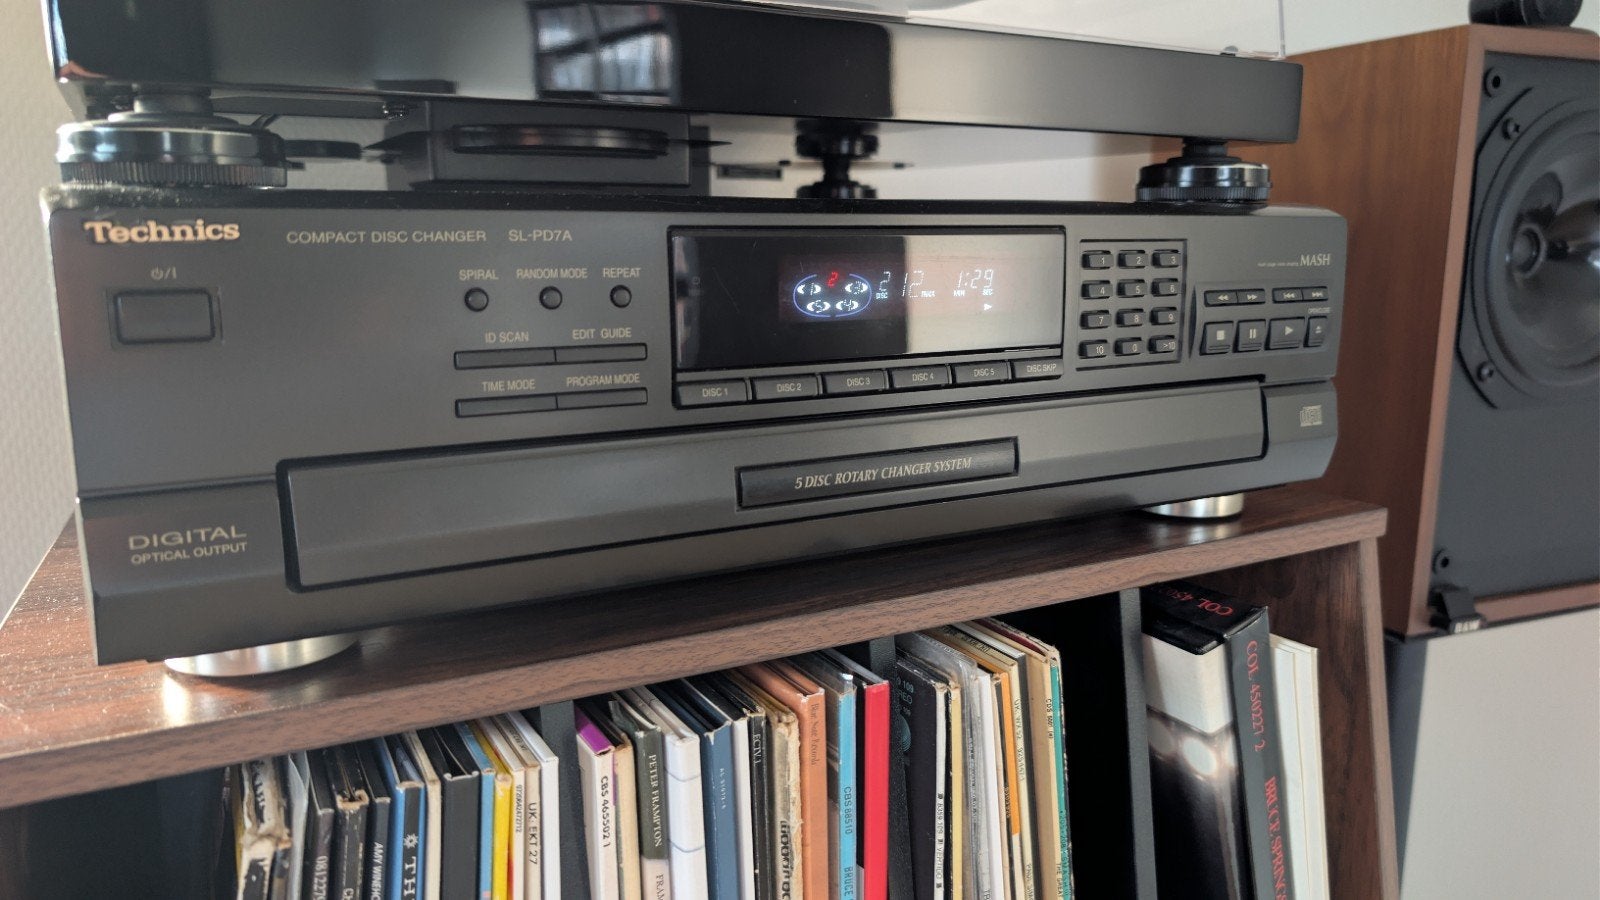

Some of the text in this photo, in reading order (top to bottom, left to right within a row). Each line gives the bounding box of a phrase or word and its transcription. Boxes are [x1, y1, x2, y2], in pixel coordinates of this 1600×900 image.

[84, 220, 240, 245] Technics
[287, 229, 573, 245] COMPACT DISC CHANGER SL-PD7A
[1136, 256, 1142, 265] 2
[1170, 256, 1176, 264] 3
[1300, 253, 1331, 267] MASH
[459, 269, 499, 281] SPIRAL
[516, 268, 588, 279] RANDOM MODE
[602, 267, 641, 278] REPEAT
[957, 269, 994, 289] 1:29
[827, 271, 838, 288] 2
[878, 271, 891, 292] 2
[1135, 285, 1140, 294] 5
[1170, 284, 1175, 293] 6
[1098, 316, 1104, 325] 7
[1134, 315, 1139, 323] 8
[1168, 313, 1174, 322] 9
[485, 331, 529, 344] ID SCAN
[572, 327, 632, 340] EDIT GUIDE
[1096, 345, 1104, 355] 10
[1132, 343, 1137, 352] 0
[973, 368, 989, 378] DISC
[1026, 363, 1057, 374] DISC SKIP
[566, 373, 640, 387] PROGRAM MODE
[846, 377, 871, 388] DISC 3
[912, 372, 935, 382] DISC 4
[482, 379, 536, 392] TIME MODE
[776, 383, 802, 393] DISC 2
[702, 388, 722, 398] DISC
[795, 456, 972, 489] 5 DISC ROTARY CHANGER SYSTEM
[128, 525, 247, 550] DIGITAL
[131, 542, 247, 565] OPTICAL OUTPUT
[1246, 639, 1267, 752] COL 450227 2
[600, 775, 609, 797] CBS
[648, 754, 664, 847] PETER FRAMPTON
[1264, 775, 1280, 835] BRUCE
[601, 800, 611, 840] 465502
[529, 826, 538, 849] EKT
[843, 786, 854, 896] CBS 88510 BRUCE
[373, 841, 384, 864] AMY
[529, 850, 538, 865] 27
[403, 856, 417, 900] TH
